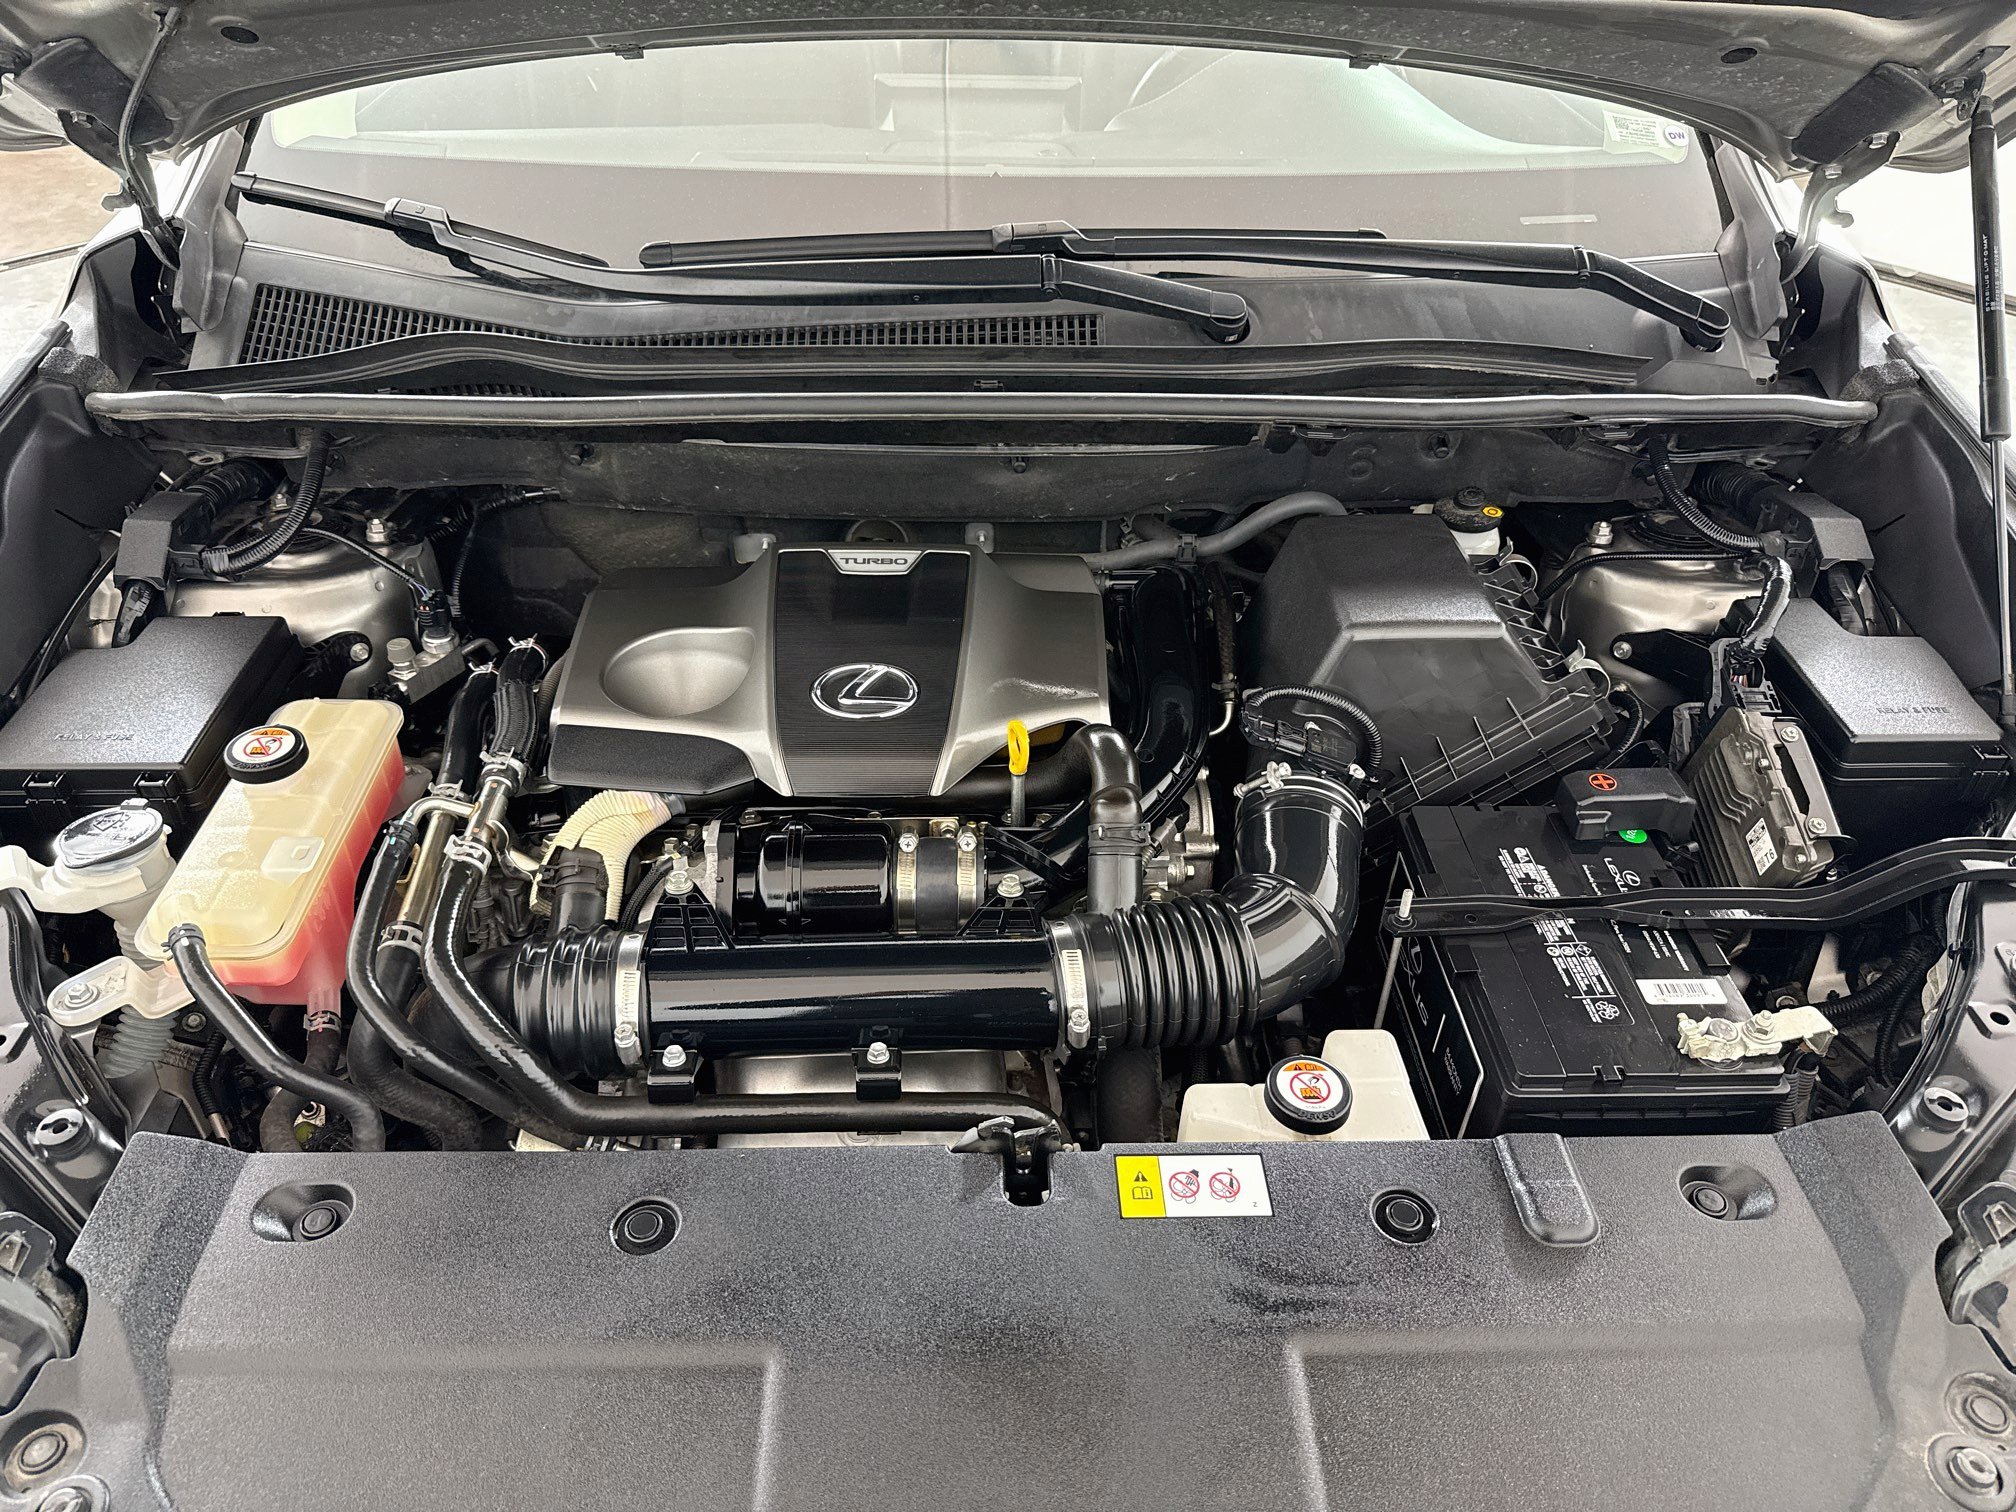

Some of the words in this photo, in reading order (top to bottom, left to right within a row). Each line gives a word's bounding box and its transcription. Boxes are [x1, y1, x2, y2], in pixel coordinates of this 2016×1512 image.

[1668, 131, 1685, 140] DW
[1876, 706, 1910, 714] RELAY
[54, 733, 93, 742] RELAY
[103, 733, 135, 741] FUSE
[1603, 857, 1628, 893] LEXU
[1297, 1110, 1336, 1120] DENSO
